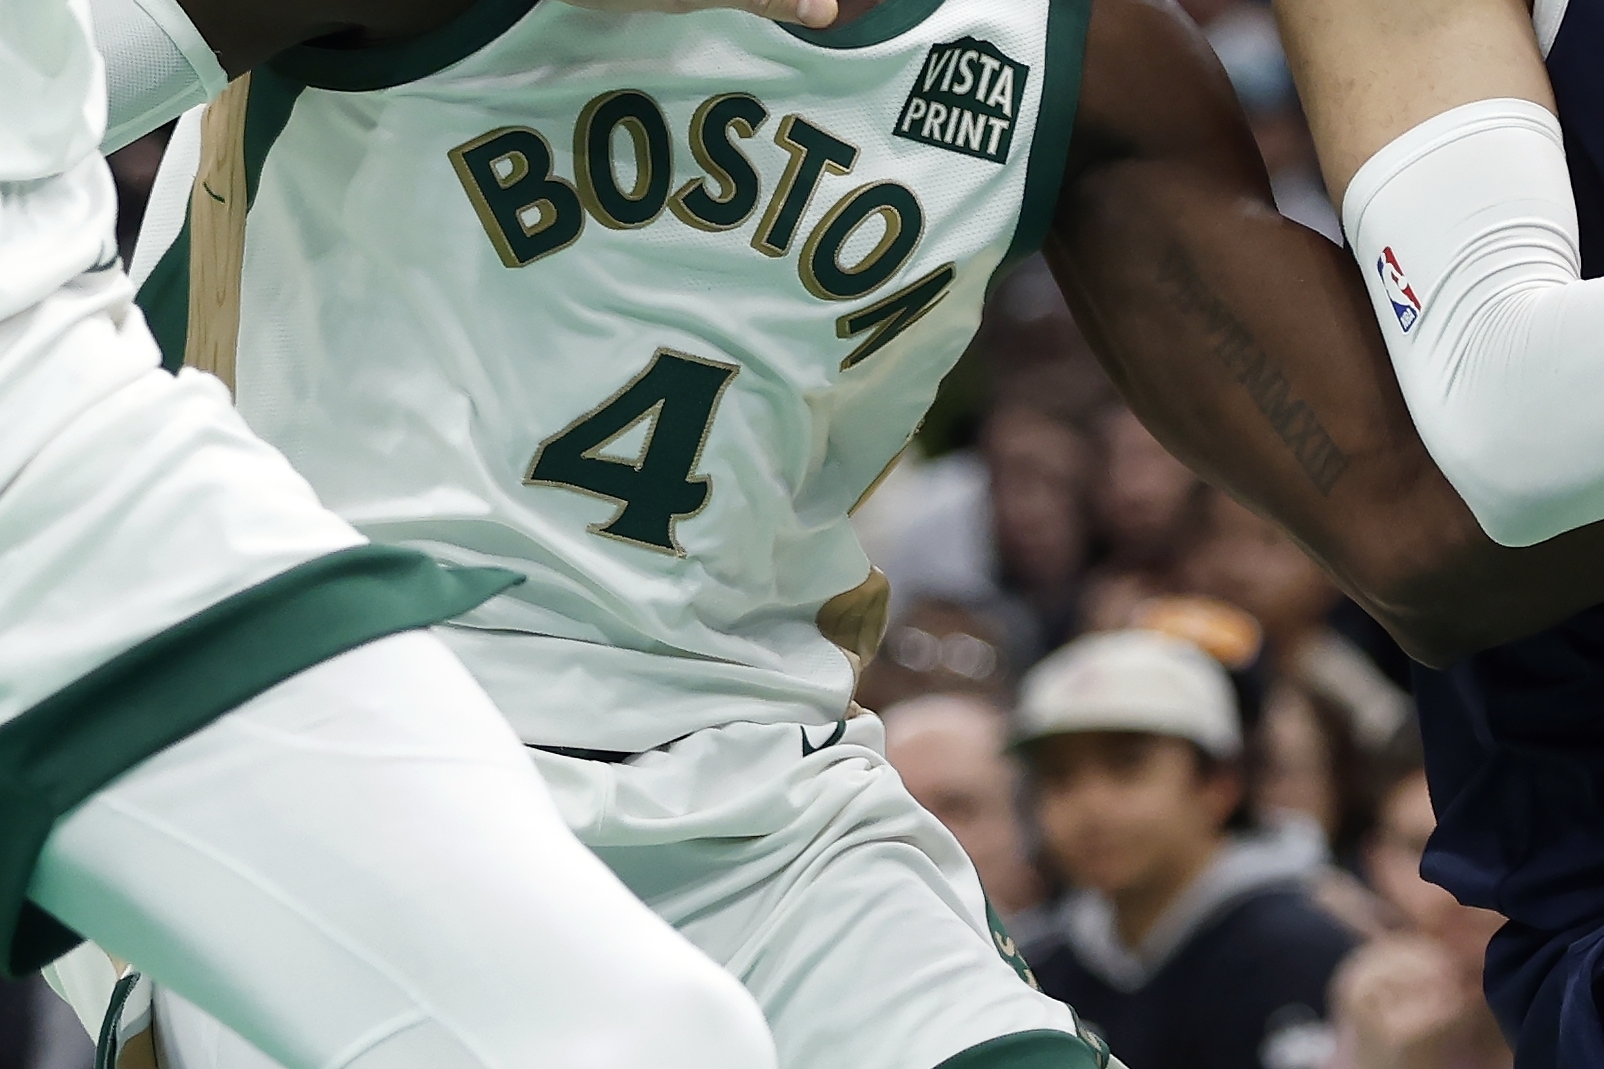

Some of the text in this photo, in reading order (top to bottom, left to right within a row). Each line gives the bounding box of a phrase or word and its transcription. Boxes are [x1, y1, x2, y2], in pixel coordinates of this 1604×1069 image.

[922, 47, 1015, 118] VISTA
[901, 96, 1010, 155] PRINT
[522, 346, 741, 559] 4
